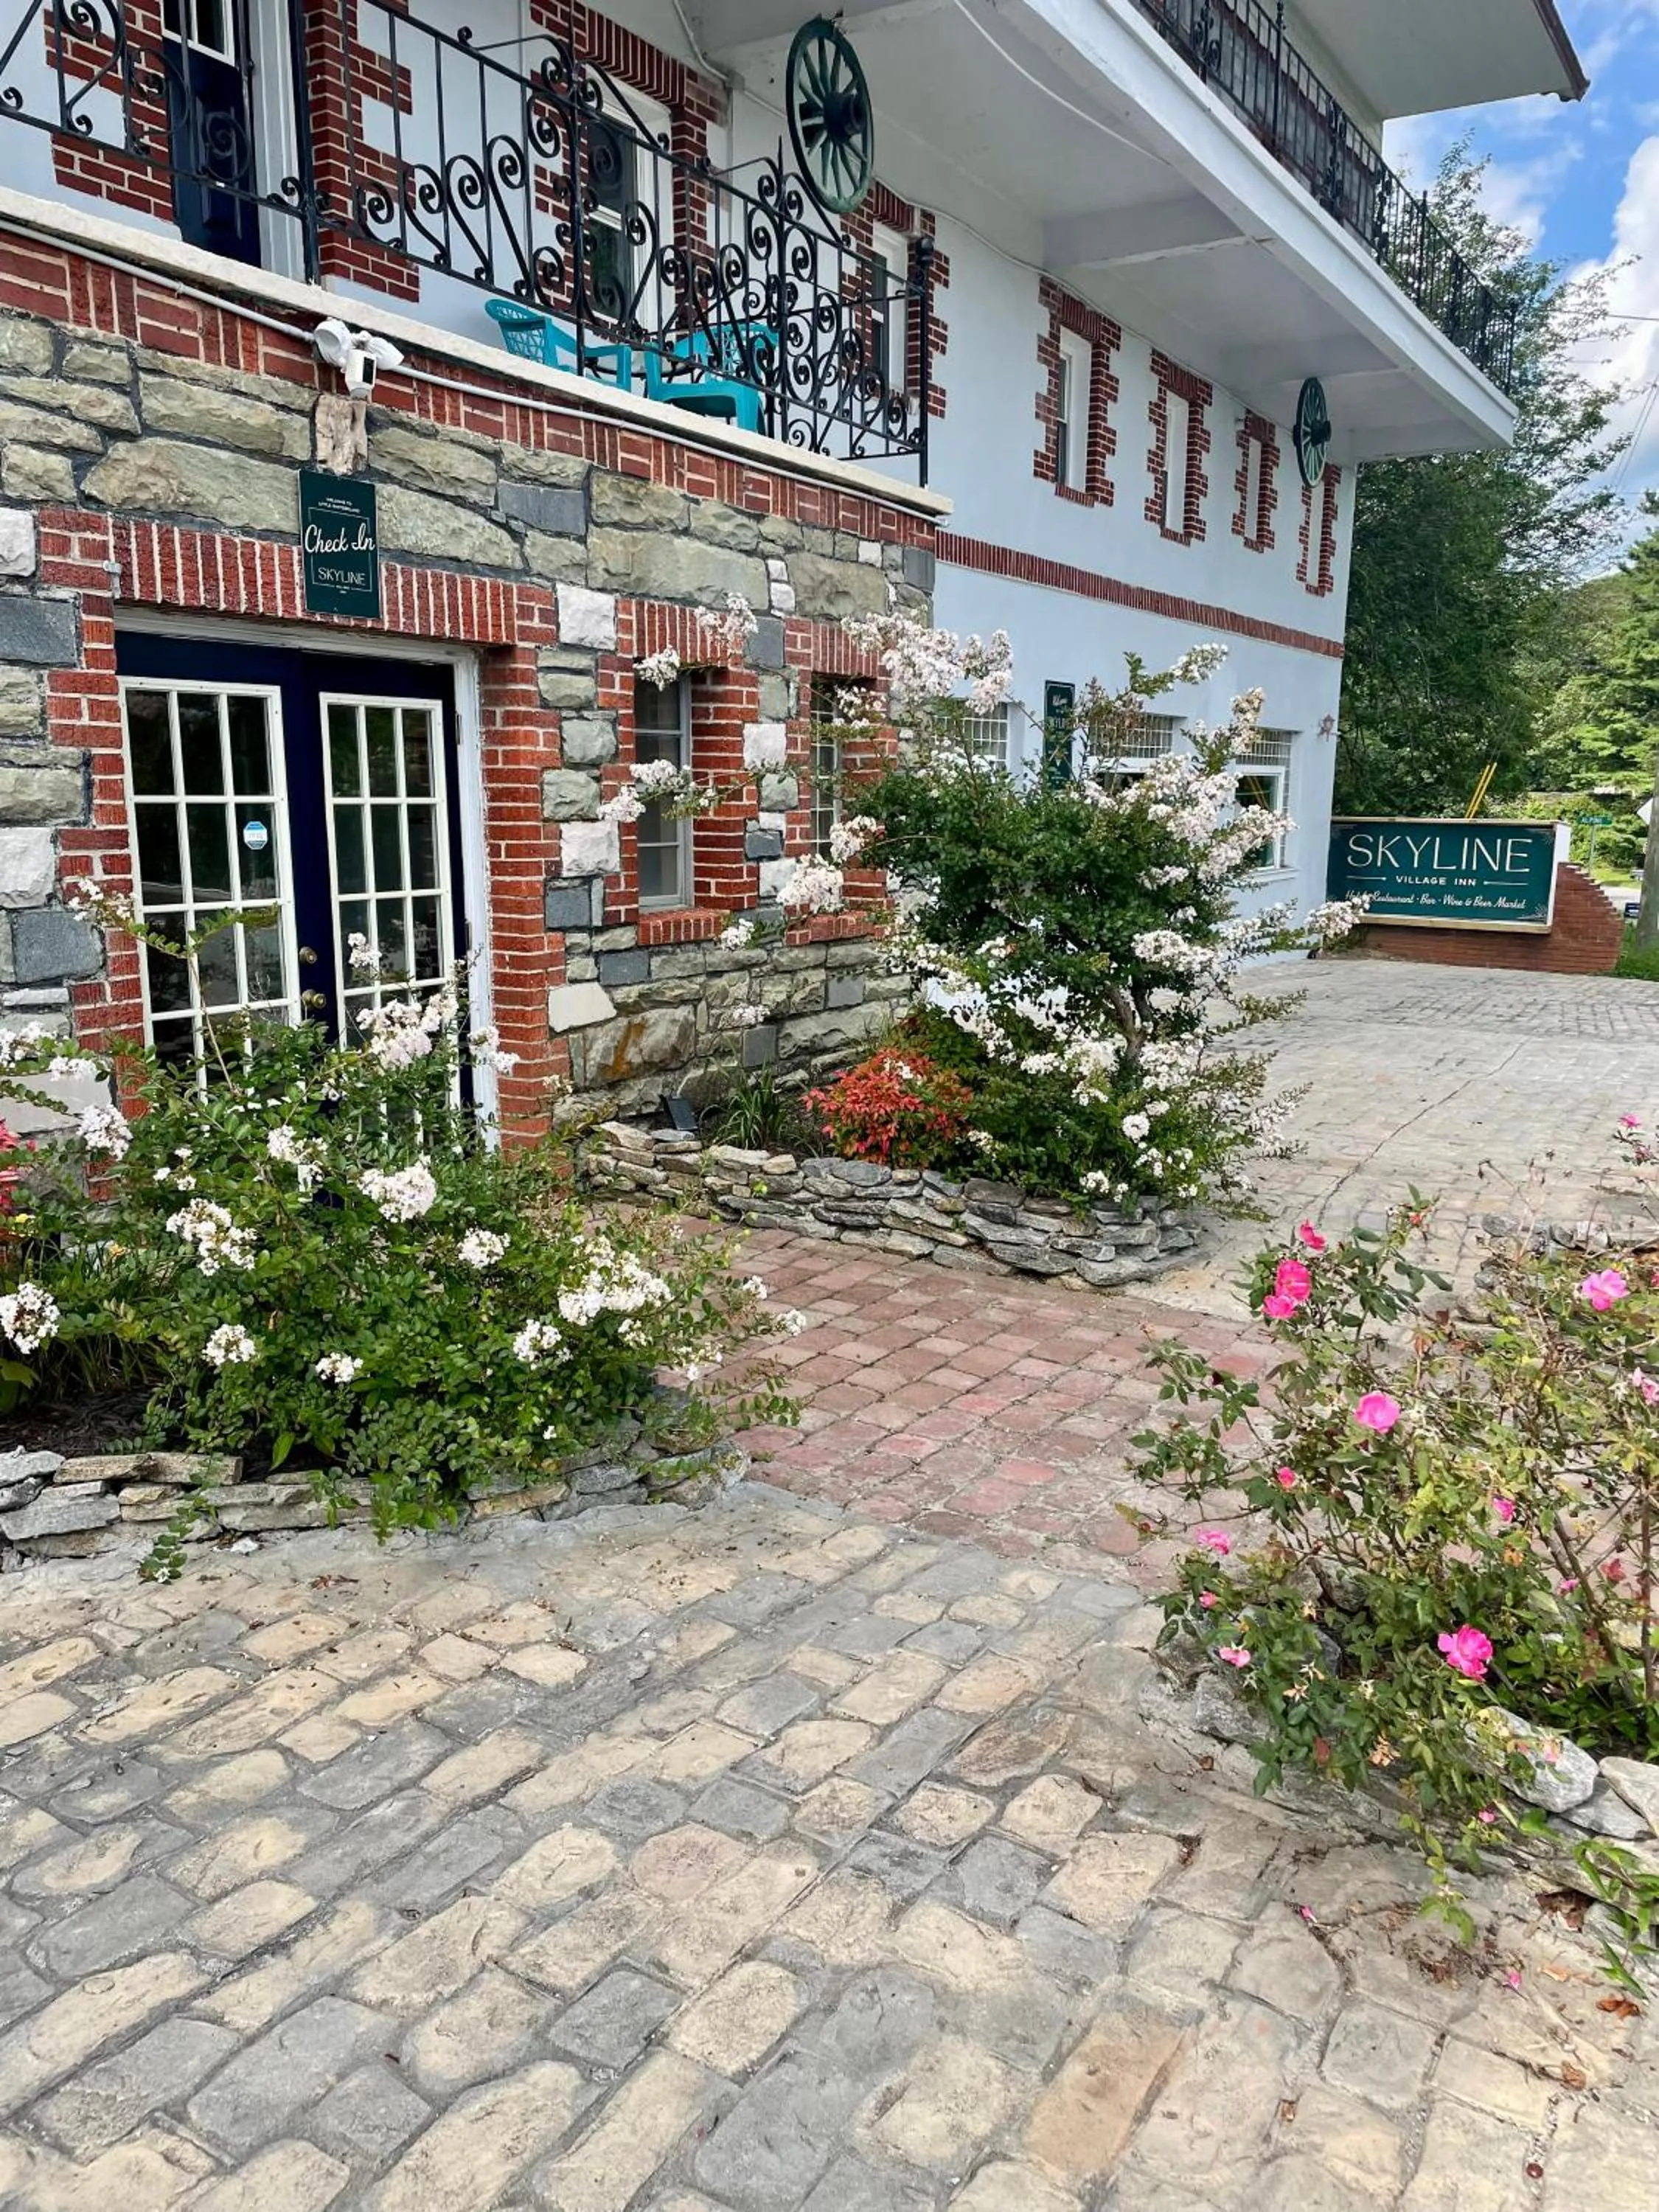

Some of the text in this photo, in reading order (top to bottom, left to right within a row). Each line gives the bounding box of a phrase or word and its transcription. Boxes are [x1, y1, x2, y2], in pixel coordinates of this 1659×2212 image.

[305, 522, 375, 554] Check In
[318, 566, 366, 586] SKYLINE
[1346, 833, 1533, 873] SKYLINE
[1395, 875, 1477, 888] VILLAGE INN
[1371, 891, 1415, 903] Restaurant
[1419, 892, 1436, 905] Bar
[1442, 894, 1463, 907] Wine
[1464, 897, 1472, 907] &
[1472, 894, 1492, 908] Beer
[1493, 895, 1526, 909] Market
